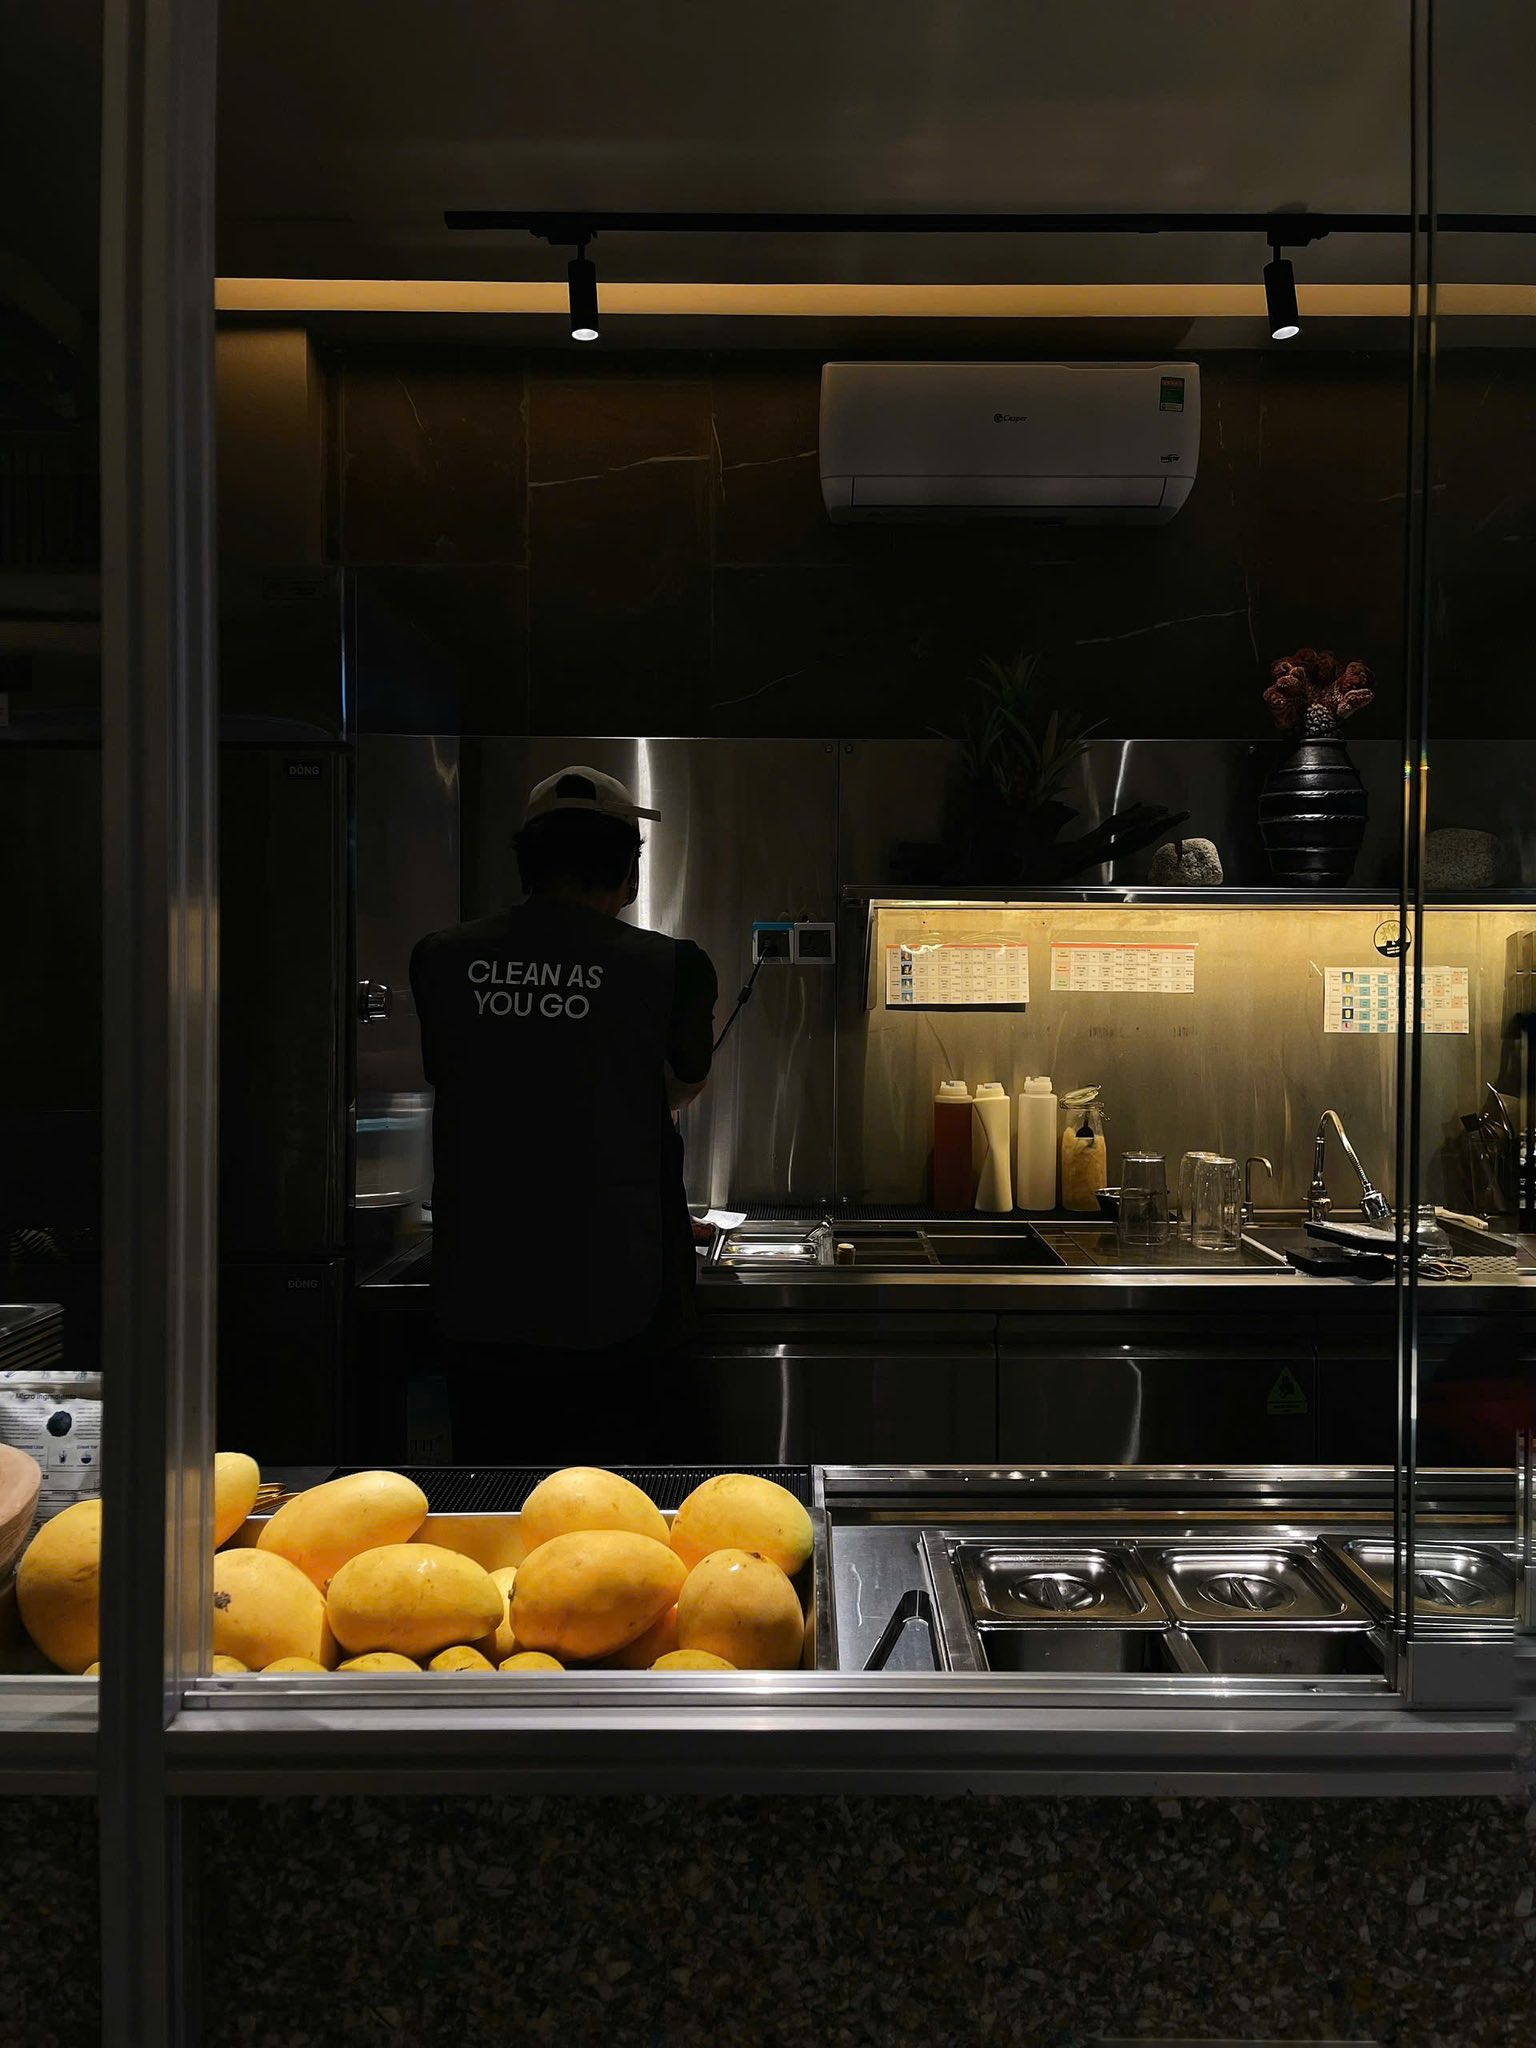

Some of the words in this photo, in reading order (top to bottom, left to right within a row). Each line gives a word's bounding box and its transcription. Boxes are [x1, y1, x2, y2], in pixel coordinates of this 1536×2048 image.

[467, 959, 562, 987] CLEAN
[566, 963, 604, 989] AS
[473, 990, 533, 1017] YOU
[539, 993, 590, 1020] GO
[15, 1392, 36, 1400] Micro
